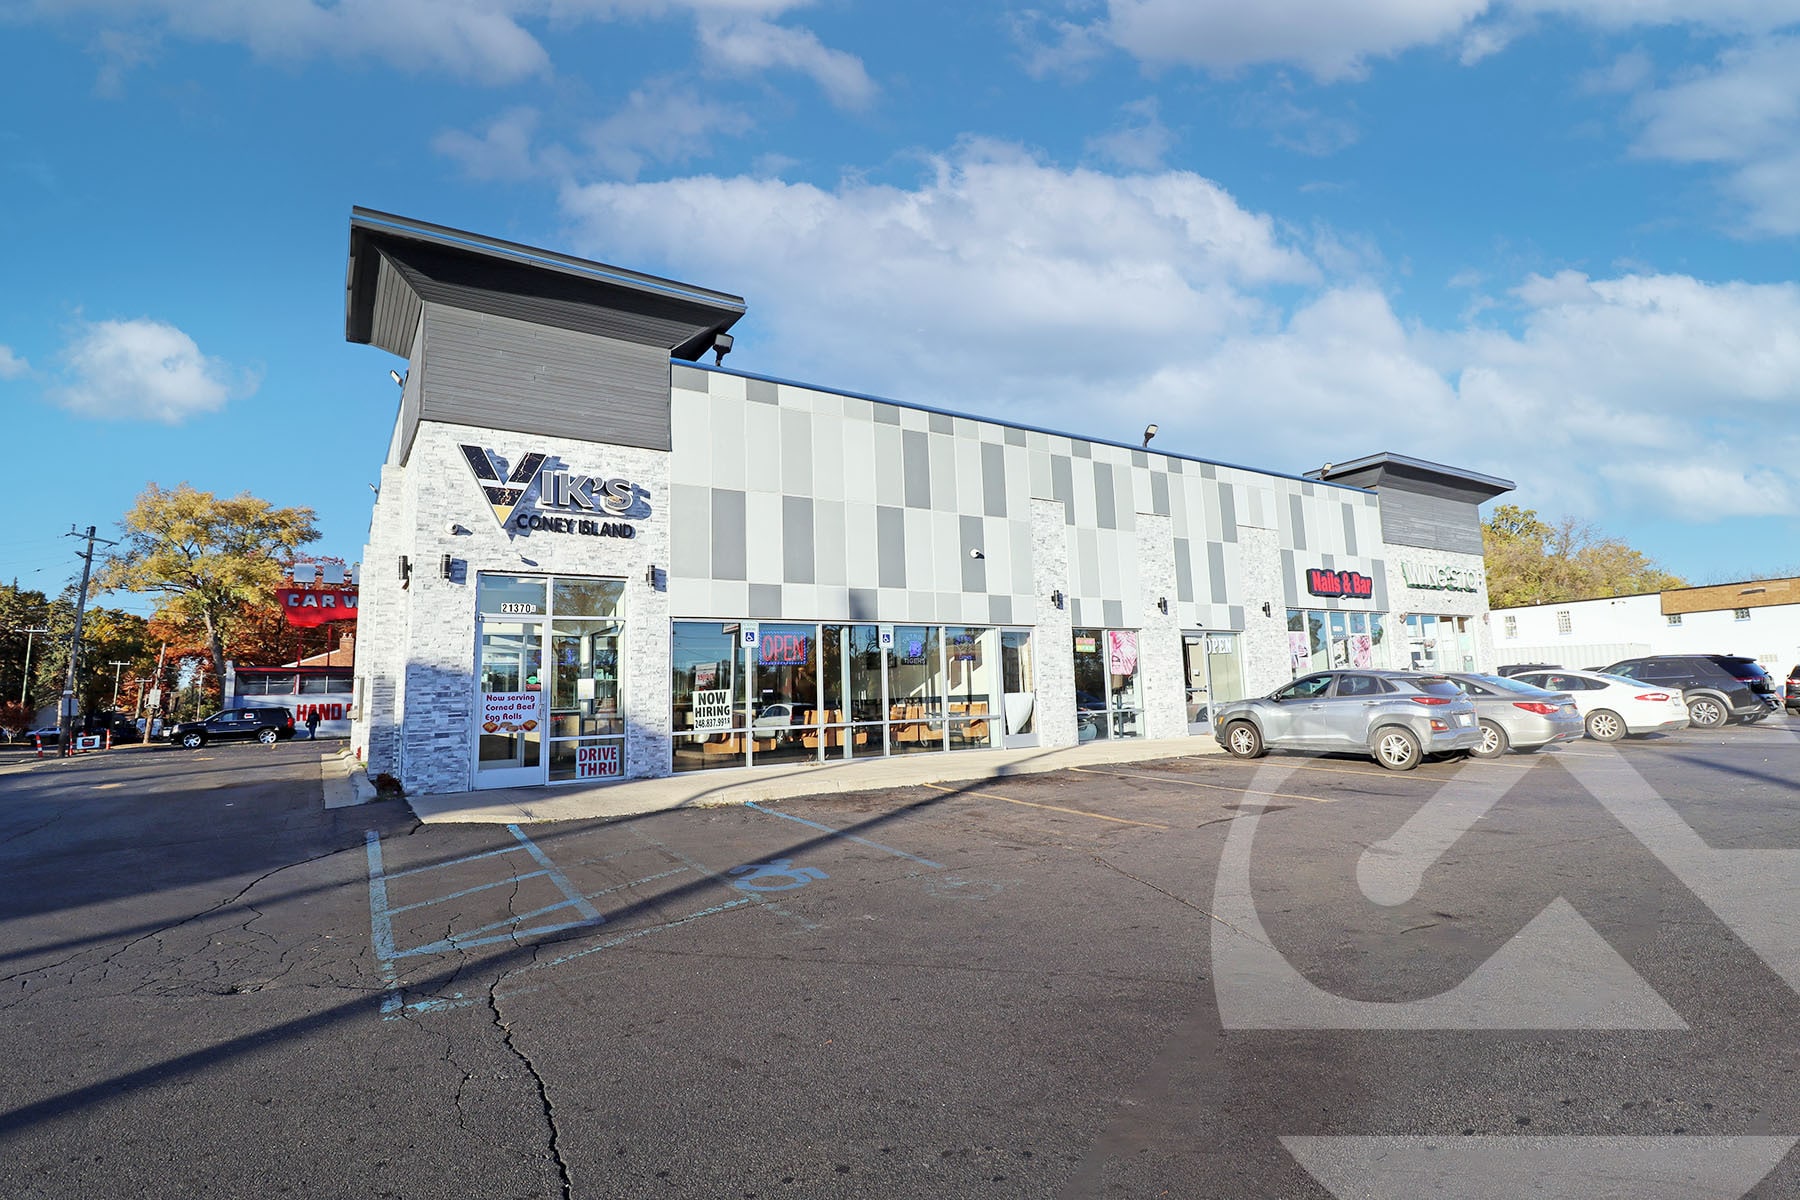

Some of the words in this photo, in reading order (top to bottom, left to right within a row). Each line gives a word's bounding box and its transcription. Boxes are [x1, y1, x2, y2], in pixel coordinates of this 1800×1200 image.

[457, 443, 633, 528] VIK'S
[516, 513, 574, 535] CONEY
[577, 519, 634, 539] ISLAND
[1311, 570, 1341, 593] Nails
[1341, 572, 1352, 593] &
[1352, 573, 1371, 594] Bar
[287, 593, 336, 608] CAR
[502, 603, 531, 613] 21370
[761, 635, 805, 662] OPEN
[486, 694, 505, 702] Now
[507, 694, 536, 703] serving
[698, 691, 727, 706] NOW
[485, 703, 515, 711] Corned
[516, 702, 536, 711] Beef
[695, 705, 730, 718] HIRING
[485, 713, 500, 722] Egg
[502, 713, 522, 721] Rolls
[578, 746, 617, 761] DRIVE
[578, 762, 617, 776] THRU
